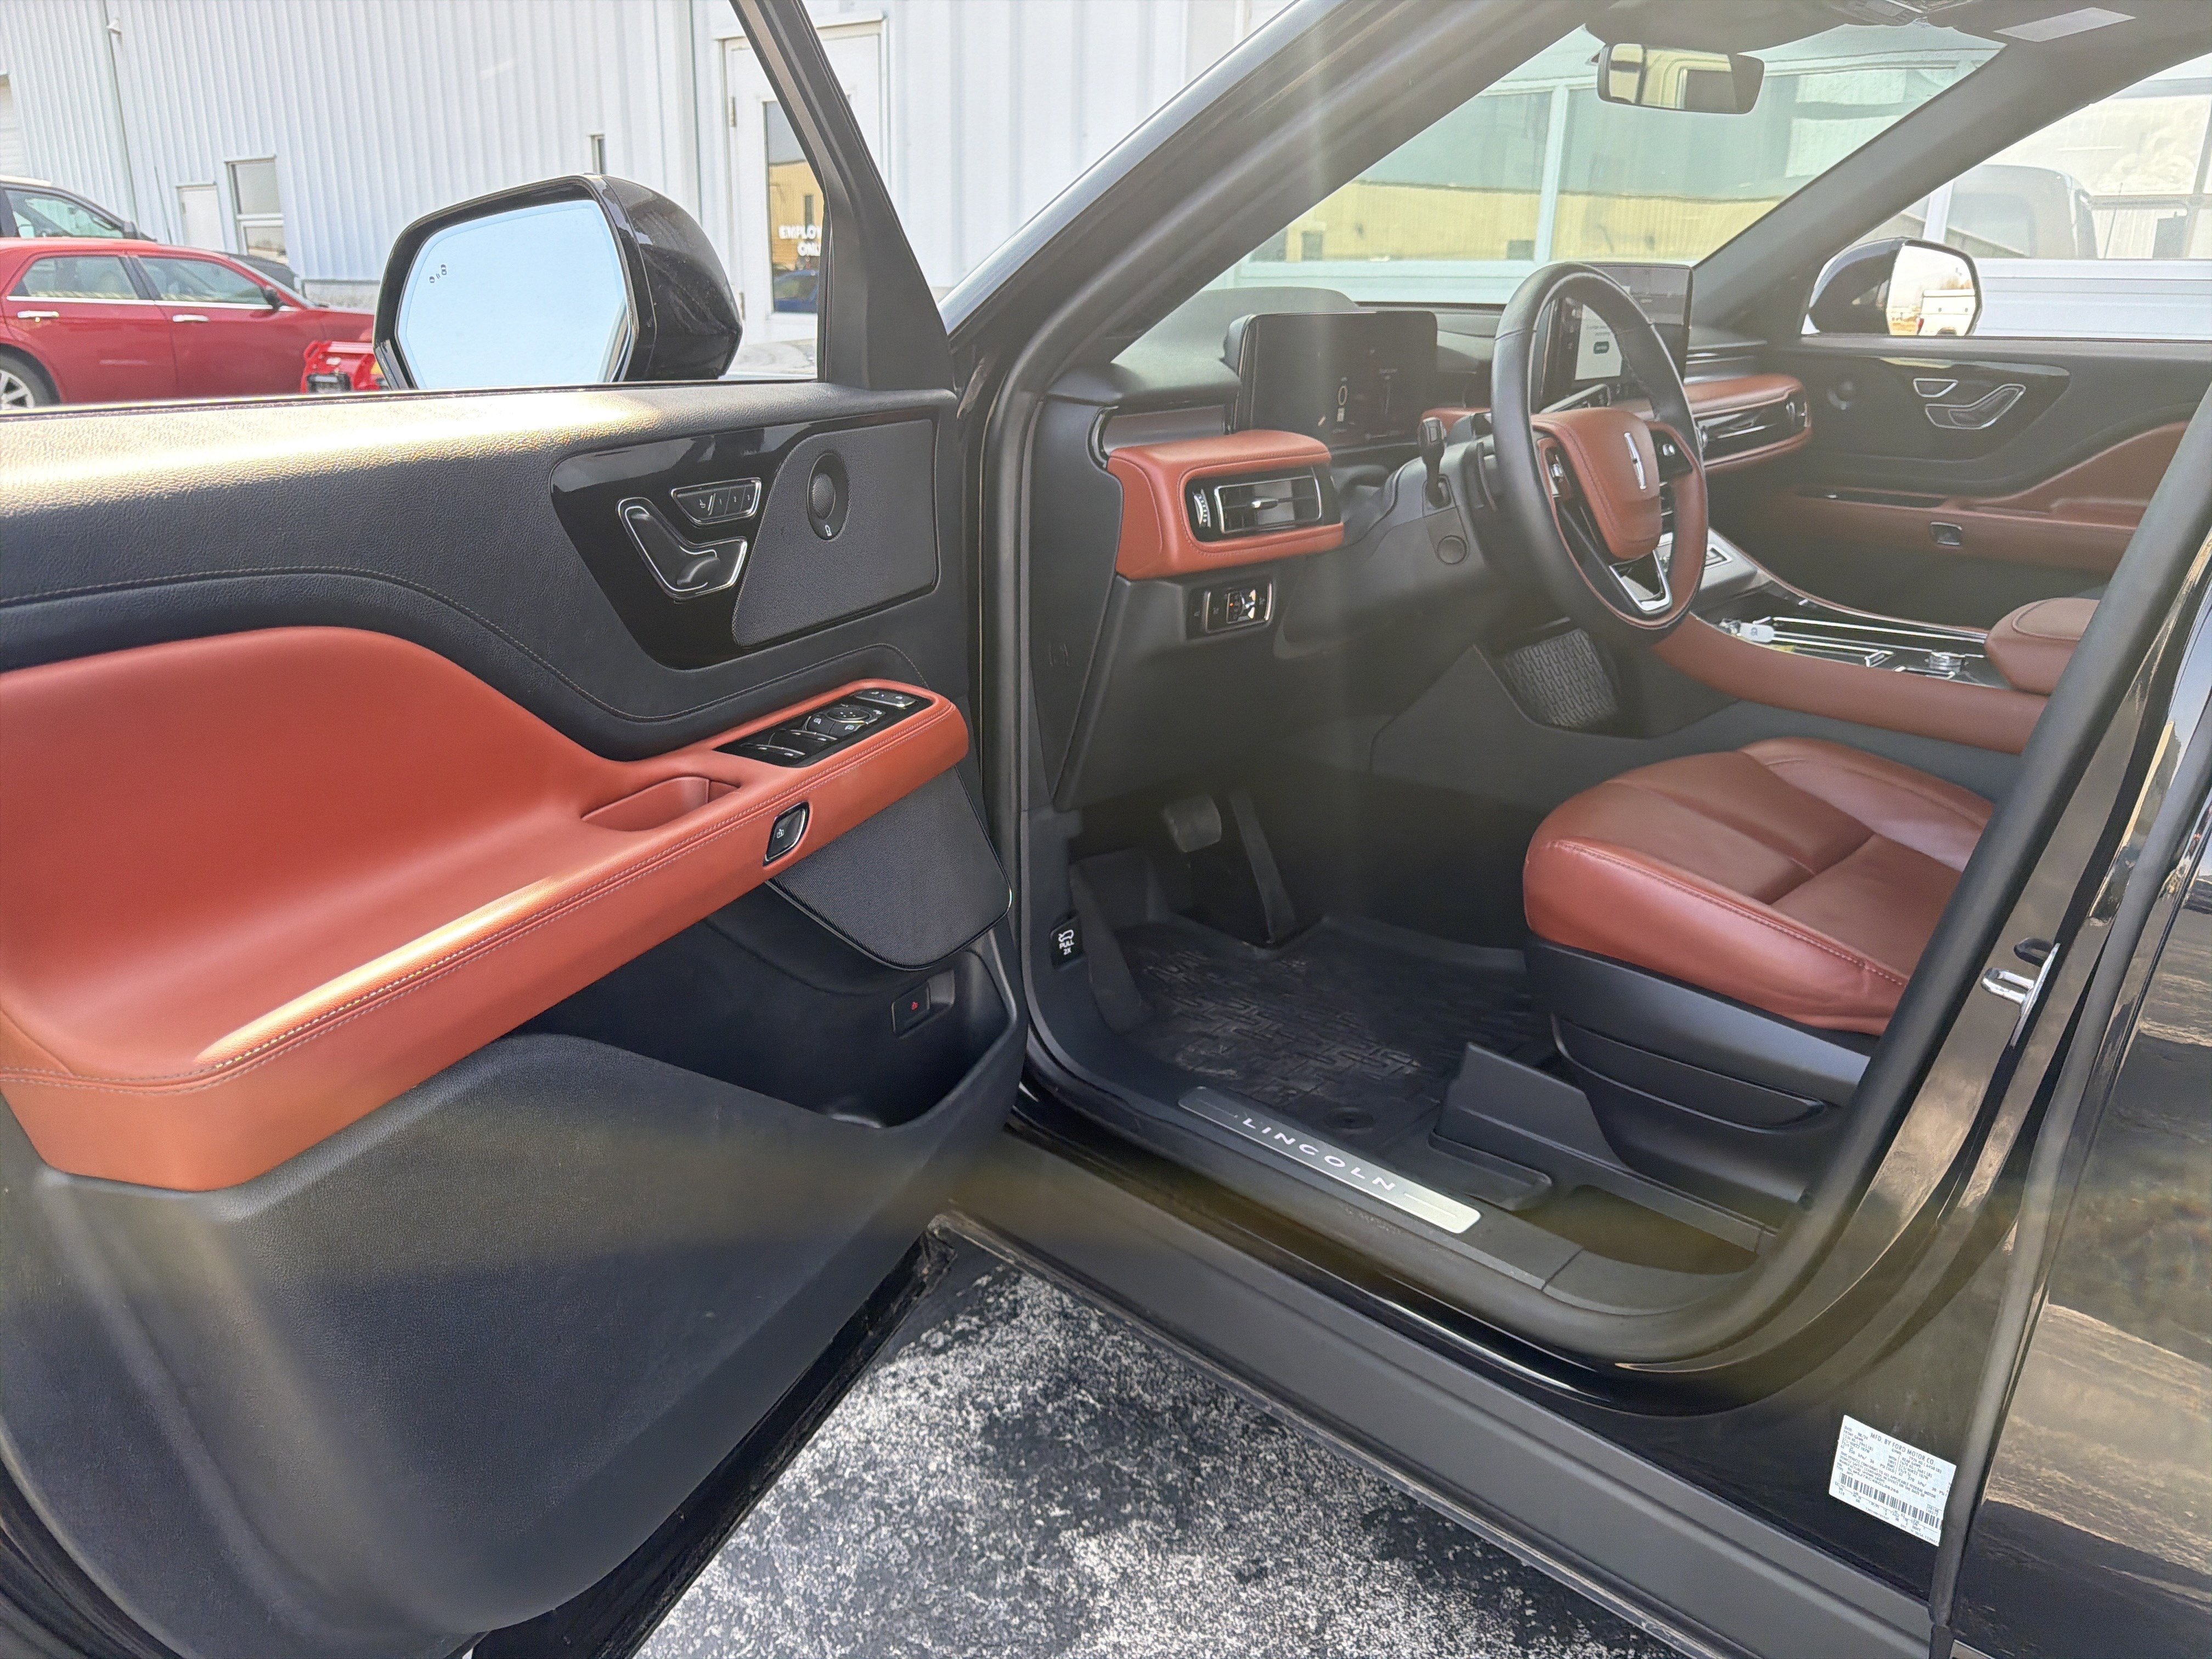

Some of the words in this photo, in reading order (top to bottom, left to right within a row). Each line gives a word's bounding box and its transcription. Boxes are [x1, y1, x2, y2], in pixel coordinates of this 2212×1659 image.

[1059, 939, 1075, 950] PULL
[1063, 947, 1071, 956] 2X
[1242, 1117, 1395, 1191] LINCOLN
[1884, 1438, 1891, 1446] BY
[1892, 1441, 1906, 1453] FORD
[1906, 1448, 1926, 1462] MOTOR
[1926, 1457, 1936, 1466] CO.
